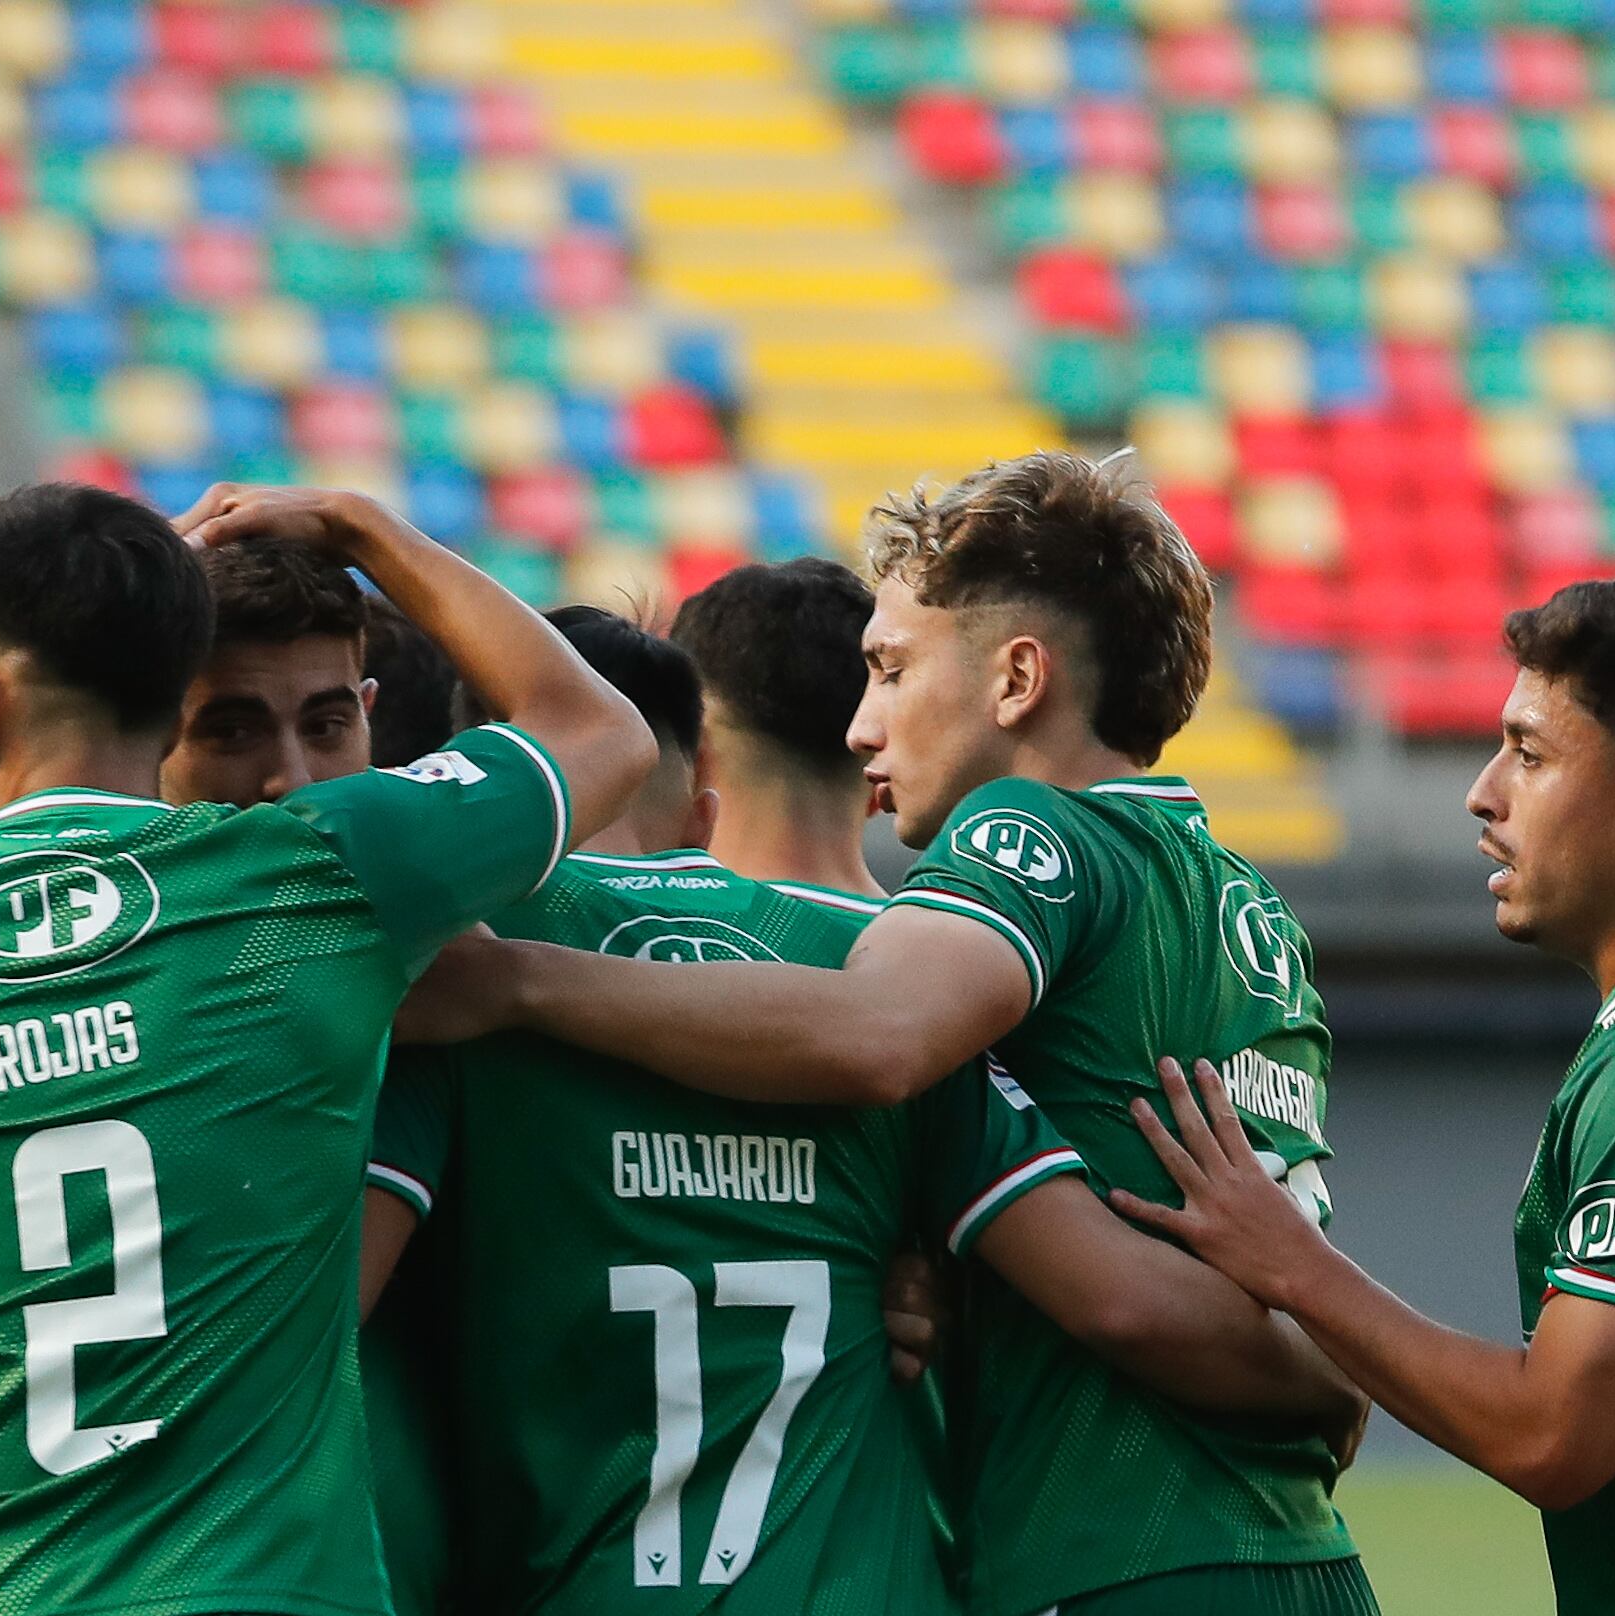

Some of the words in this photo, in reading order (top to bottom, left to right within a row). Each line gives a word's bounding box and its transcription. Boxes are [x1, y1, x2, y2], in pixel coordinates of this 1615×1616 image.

[11, 1118, 169, 1477] 2
[611, 1130, 818, 1205] GUAJARDO
[608, 1259, 832, 1588] 17
